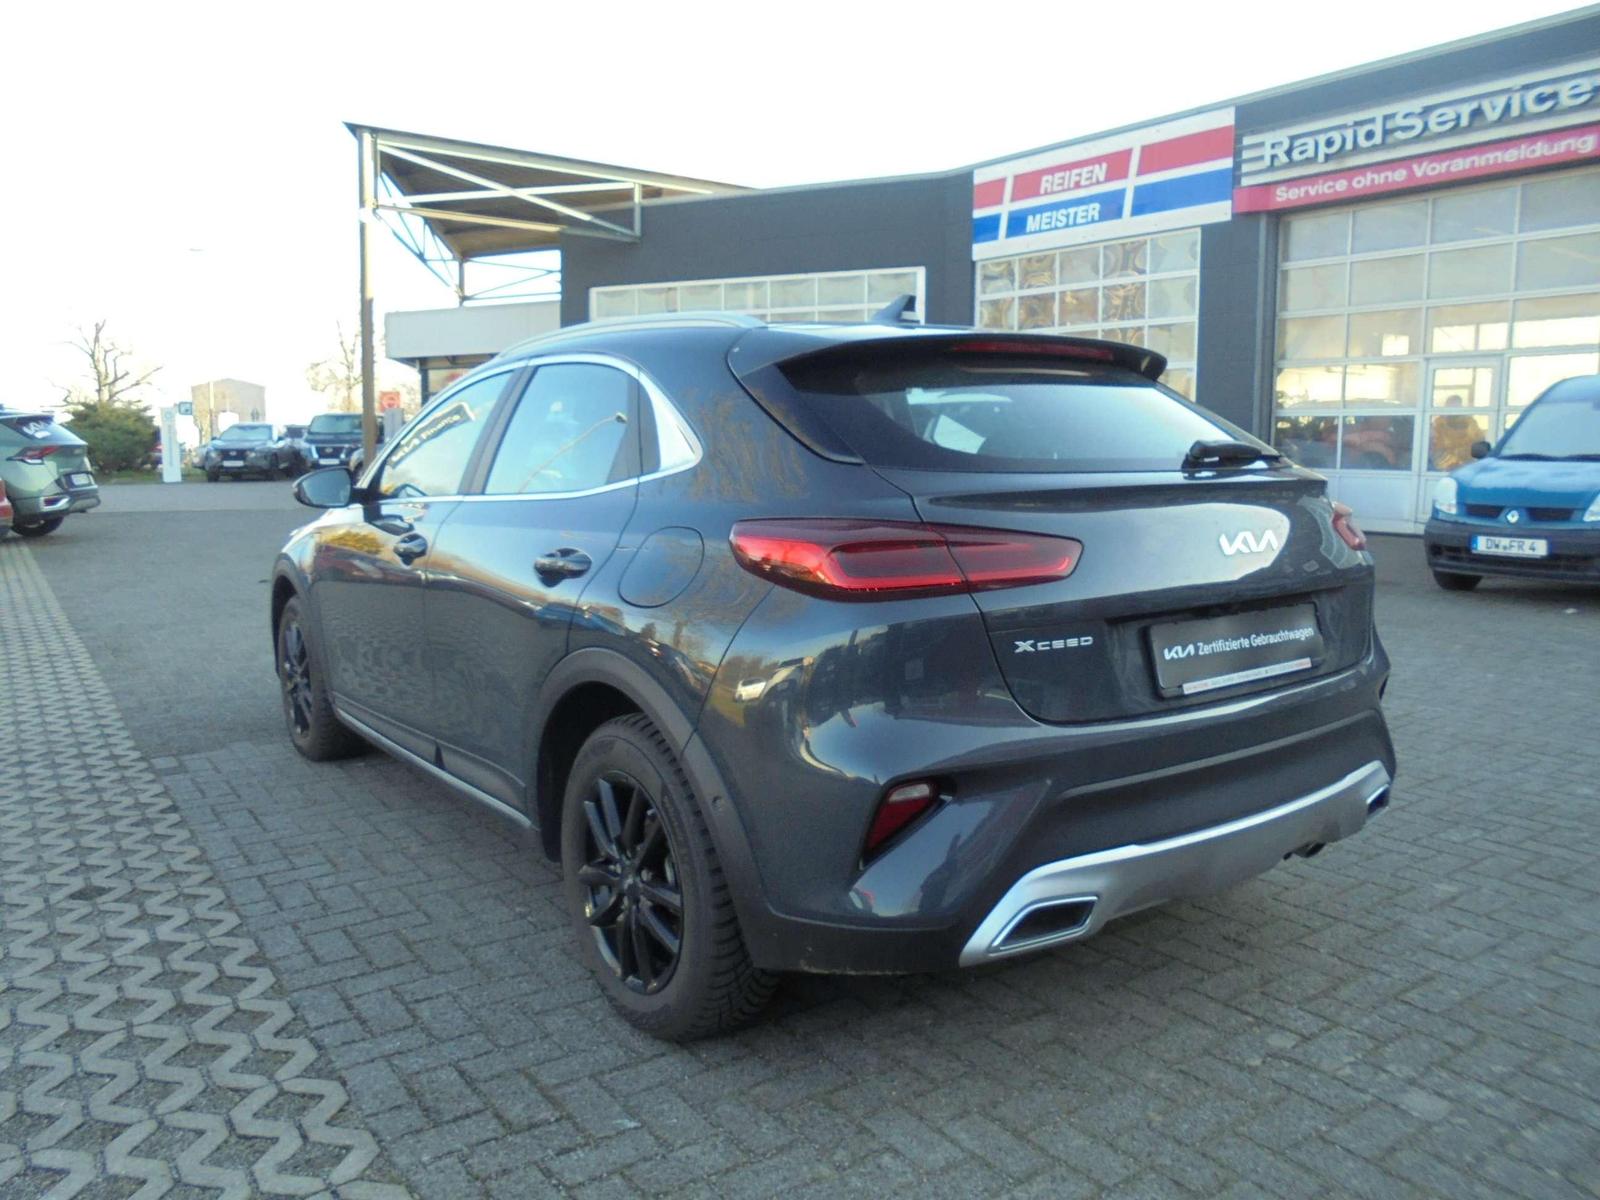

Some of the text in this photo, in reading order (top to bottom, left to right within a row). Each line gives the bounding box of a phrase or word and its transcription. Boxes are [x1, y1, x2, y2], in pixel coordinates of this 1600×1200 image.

[1040, 162, 1108, 195] REIFEN
[1275, 133, 1597, 202] Service ohne Voranmeldung
[1025, 202, 1101, 233] MEISTER
[1218, 529, 1279, 556] KIA
[1198, 636, 1250, 656] Zertifizierte
[1250, 625, 1315, 648] Gebrauchtwagen
